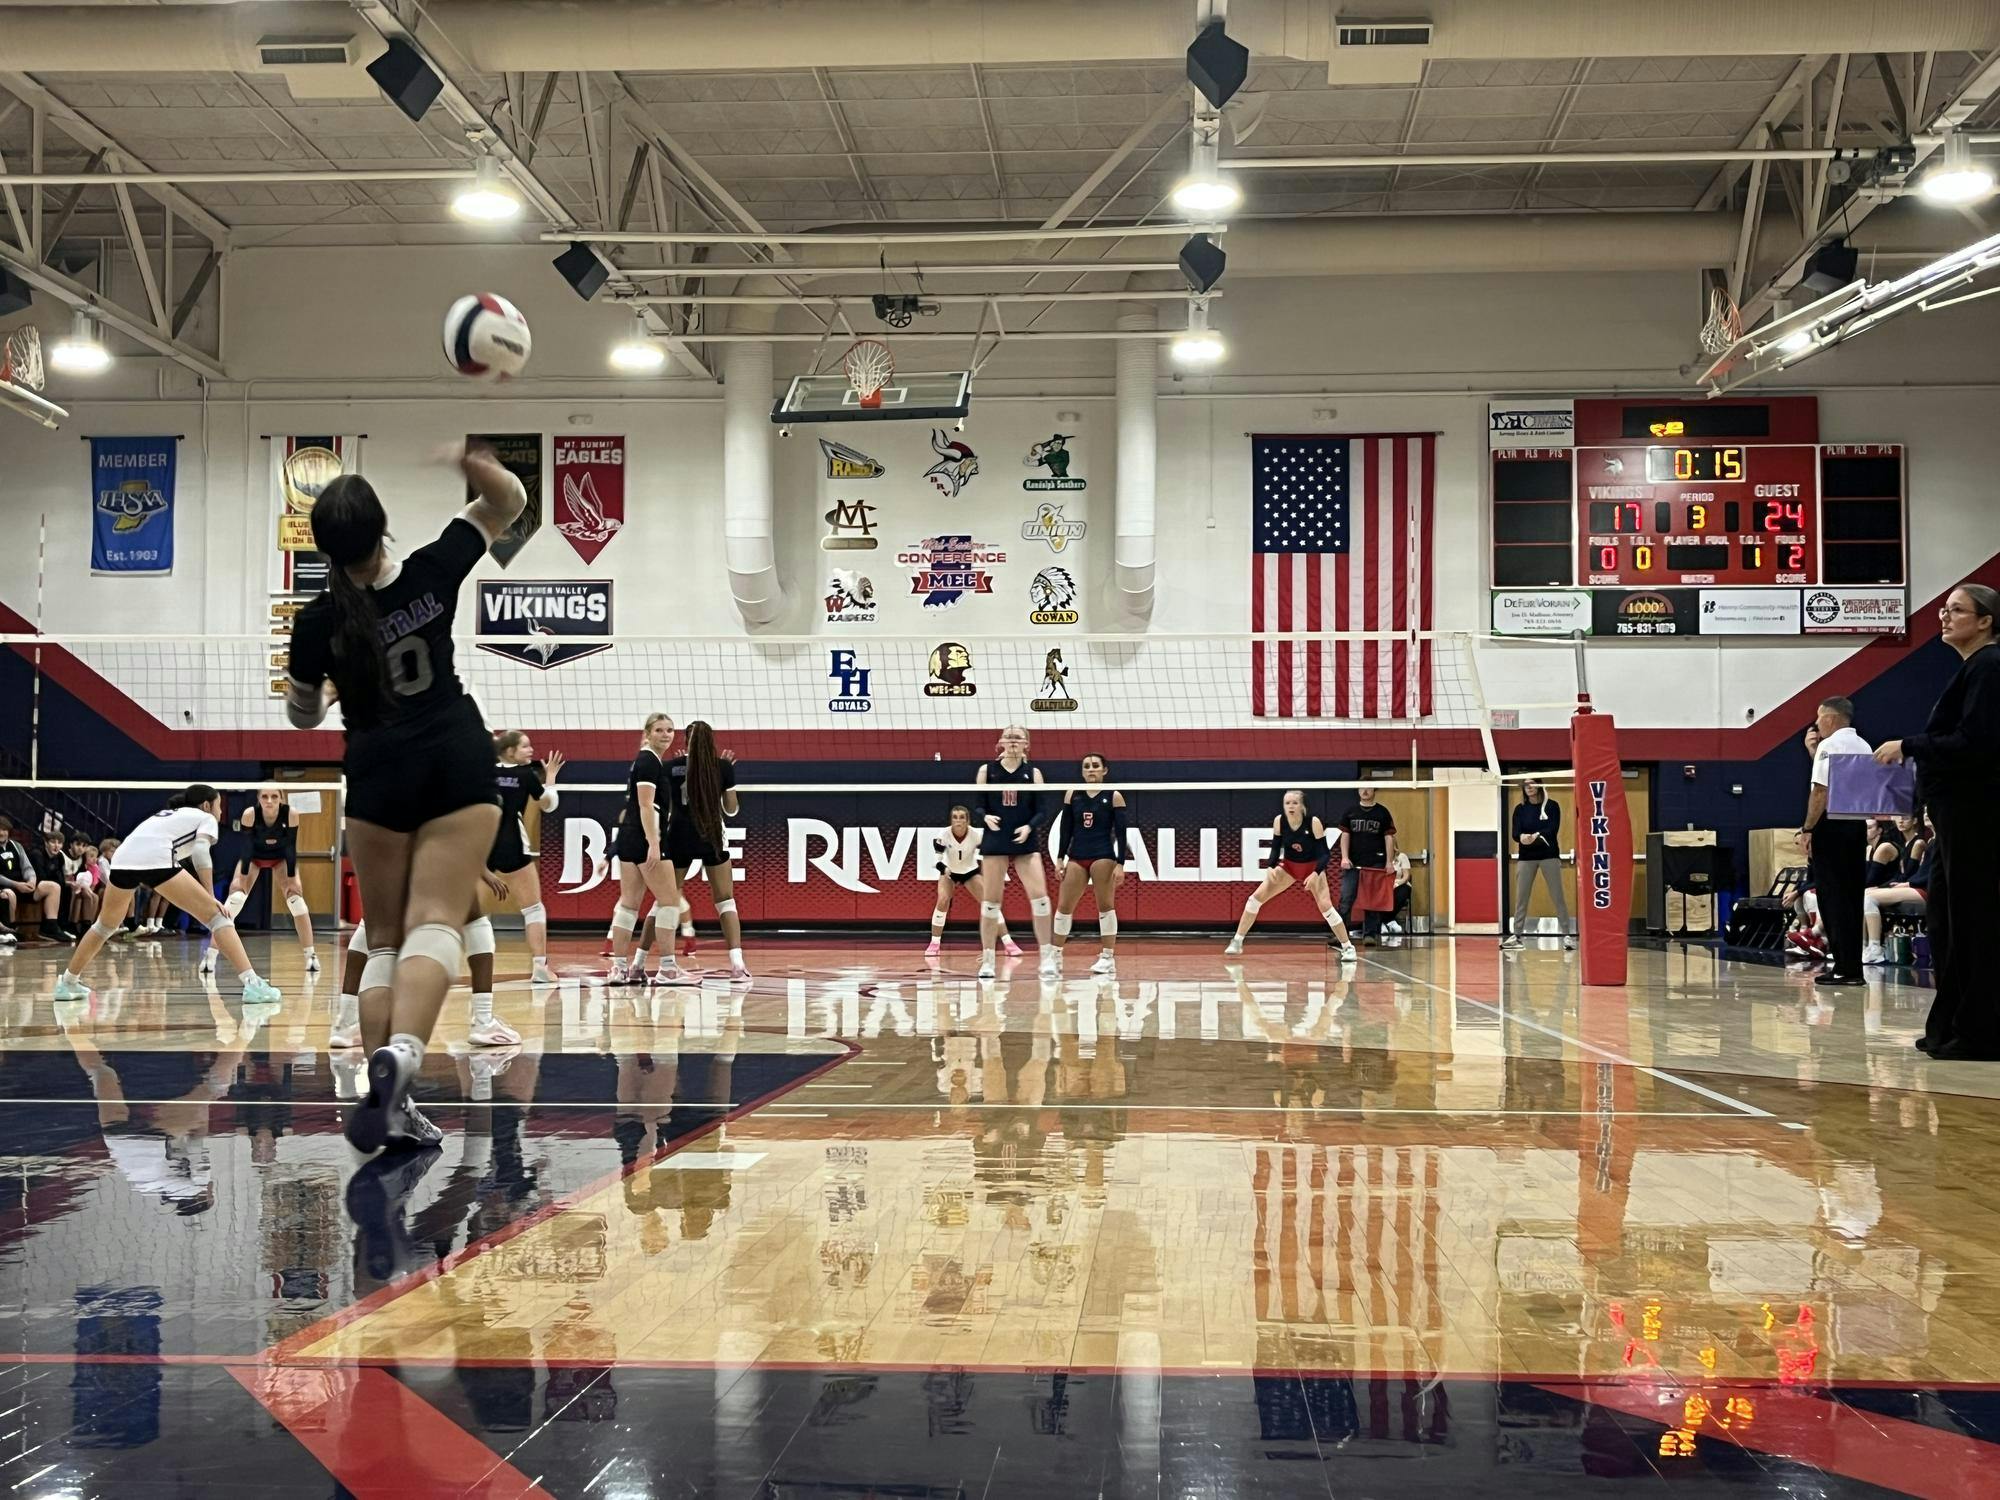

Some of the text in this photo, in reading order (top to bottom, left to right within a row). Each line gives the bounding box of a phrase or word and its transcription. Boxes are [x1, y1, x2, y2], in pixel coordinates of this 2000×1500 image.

[1498, 449, 1563, 459] PLYR FLS PTS
[1827, 445, 1893, 455] PLYR FLS PTS
[98, 453, 167, 468] MEMBER
[555, 448, 623, 465] EAGLES
[1674, 448, 1741, 480] 0:15
[1057, 480, 1085, 489] Southern
[1754, 484, 1800, 497] GUEST
[1588, 485, 1642, 499] VIKINGS
[1680, 492, 1715, 501] PERIOD
[1614, 502, 1642, 531] 17
[1692, 504, 1706, 530] 3
[1764, 501, 1805, 532] 24
[296, 528, 312, 536] VAL
[1026, 525, 1082, 536] UNION
[1589, 536, 1619, 546] FOULS
[1664, 536, 1730, 545] PLAYER FOUL
[1775, 535, 1806, 544] FOULS
[106, 550, 158, 561] Est. 1903
[897, 552, 1006, 564] CONFERENCE
[1601, 547, 1616, 570] 0
[1636, 546, 1651, 569] 0
[1754, 547, 1761, 568] 1
[1789, 545, 1804, 568] 2
[929, 573, 976, 588] MEC
[1588, 574, 1620, 585] SCORE
[1681, 574, 1715, 584] MATCH
[1775, 574, 1807, 584] SCORE
[484, 592, 606, 622] VIKINGS
[1882, 598, 1903, 607] STEEL
[827, 614, 875, 622] RAIDERS
[1035, 613, 1073, 622] COWAN
[387, 634, 435, 697] 0
[829, 649, 871, 697] EH
[929, 685, 972, 694] WES-DEL
[831, 701, 869, 711] ROYALS
[1034, 700, 1074, 710] DALEVILLE
[1083, 812, 1094, 828] 5
[1589, 781, 1611, 909] VIKINGS
[556, 809, 1342, 894] BE RIVE ALLE
